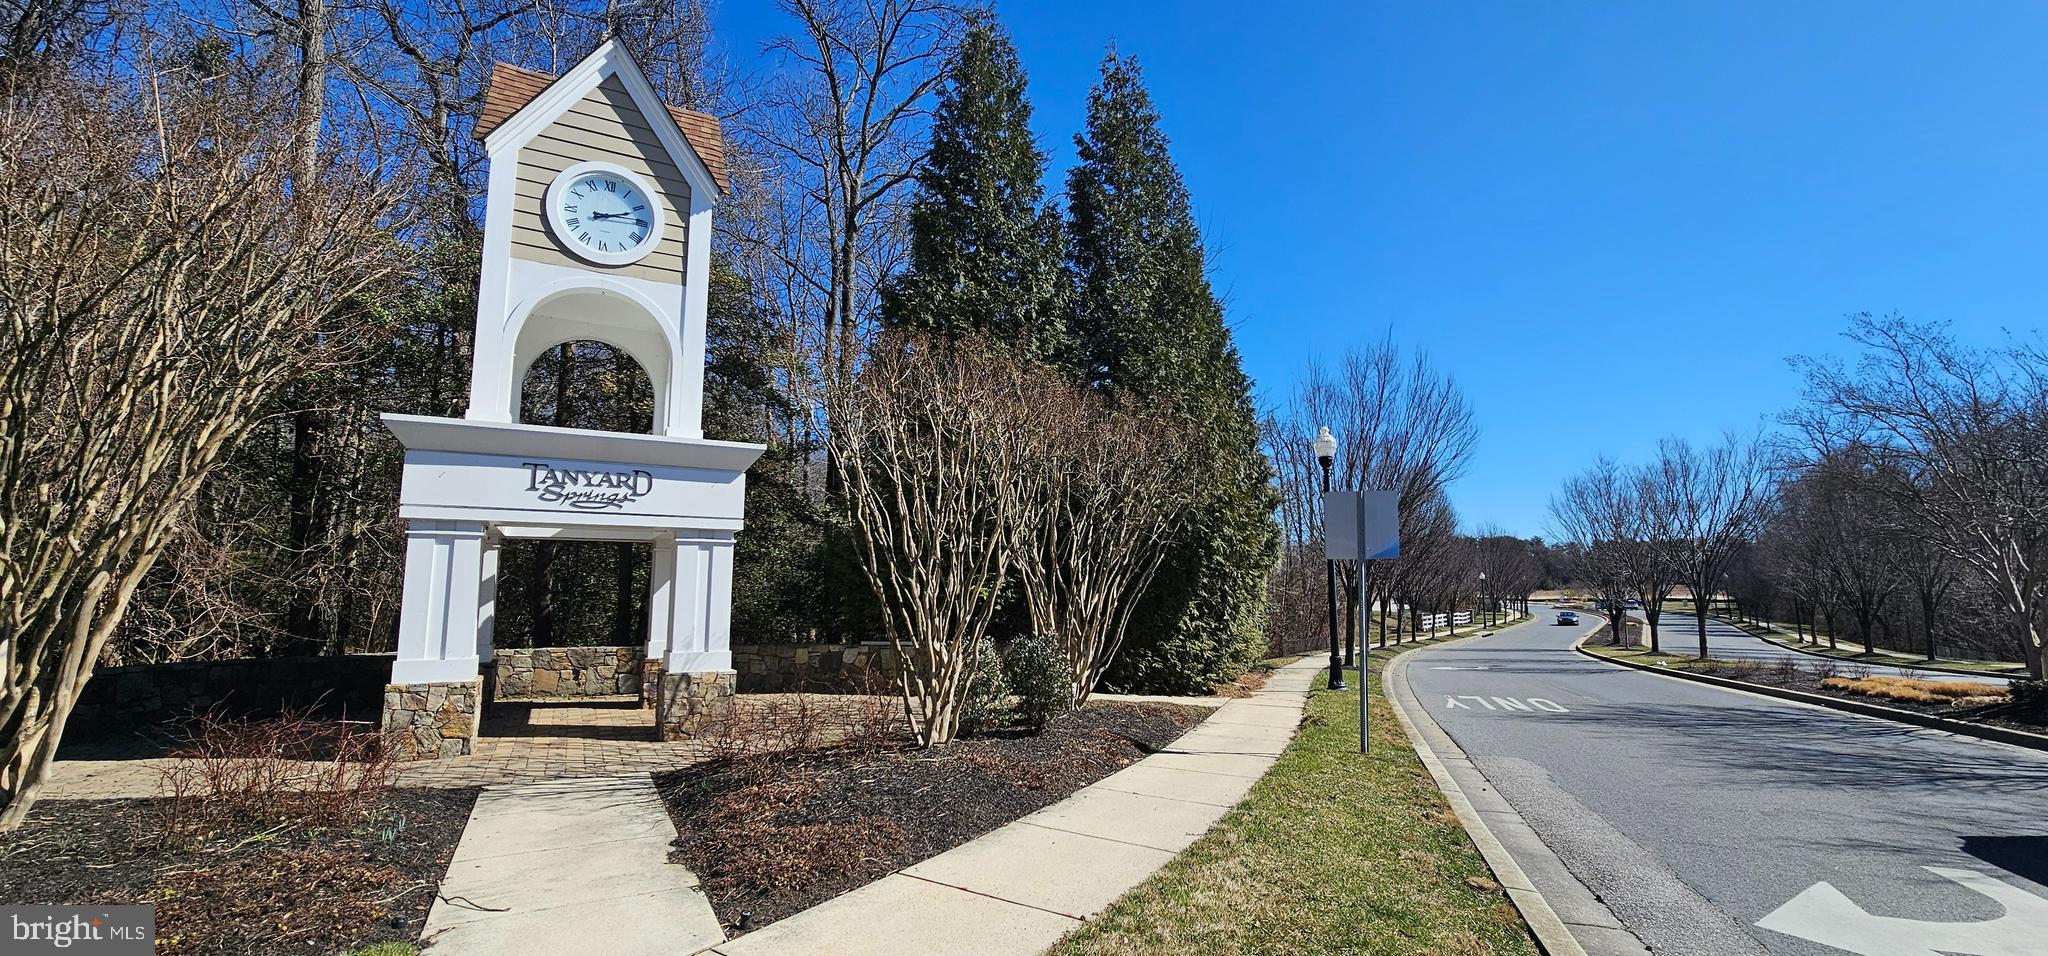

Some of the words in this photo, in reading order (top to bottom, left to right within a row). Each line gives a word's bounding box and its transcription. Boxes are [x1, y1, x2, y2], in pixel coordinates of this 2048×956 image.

[604, 180, 616, 192] XII
[522, 462, 653, 497] TANYARD
[537, 484, 637, 510] Springs
[1443, 695, 1570, 713] ONLY
